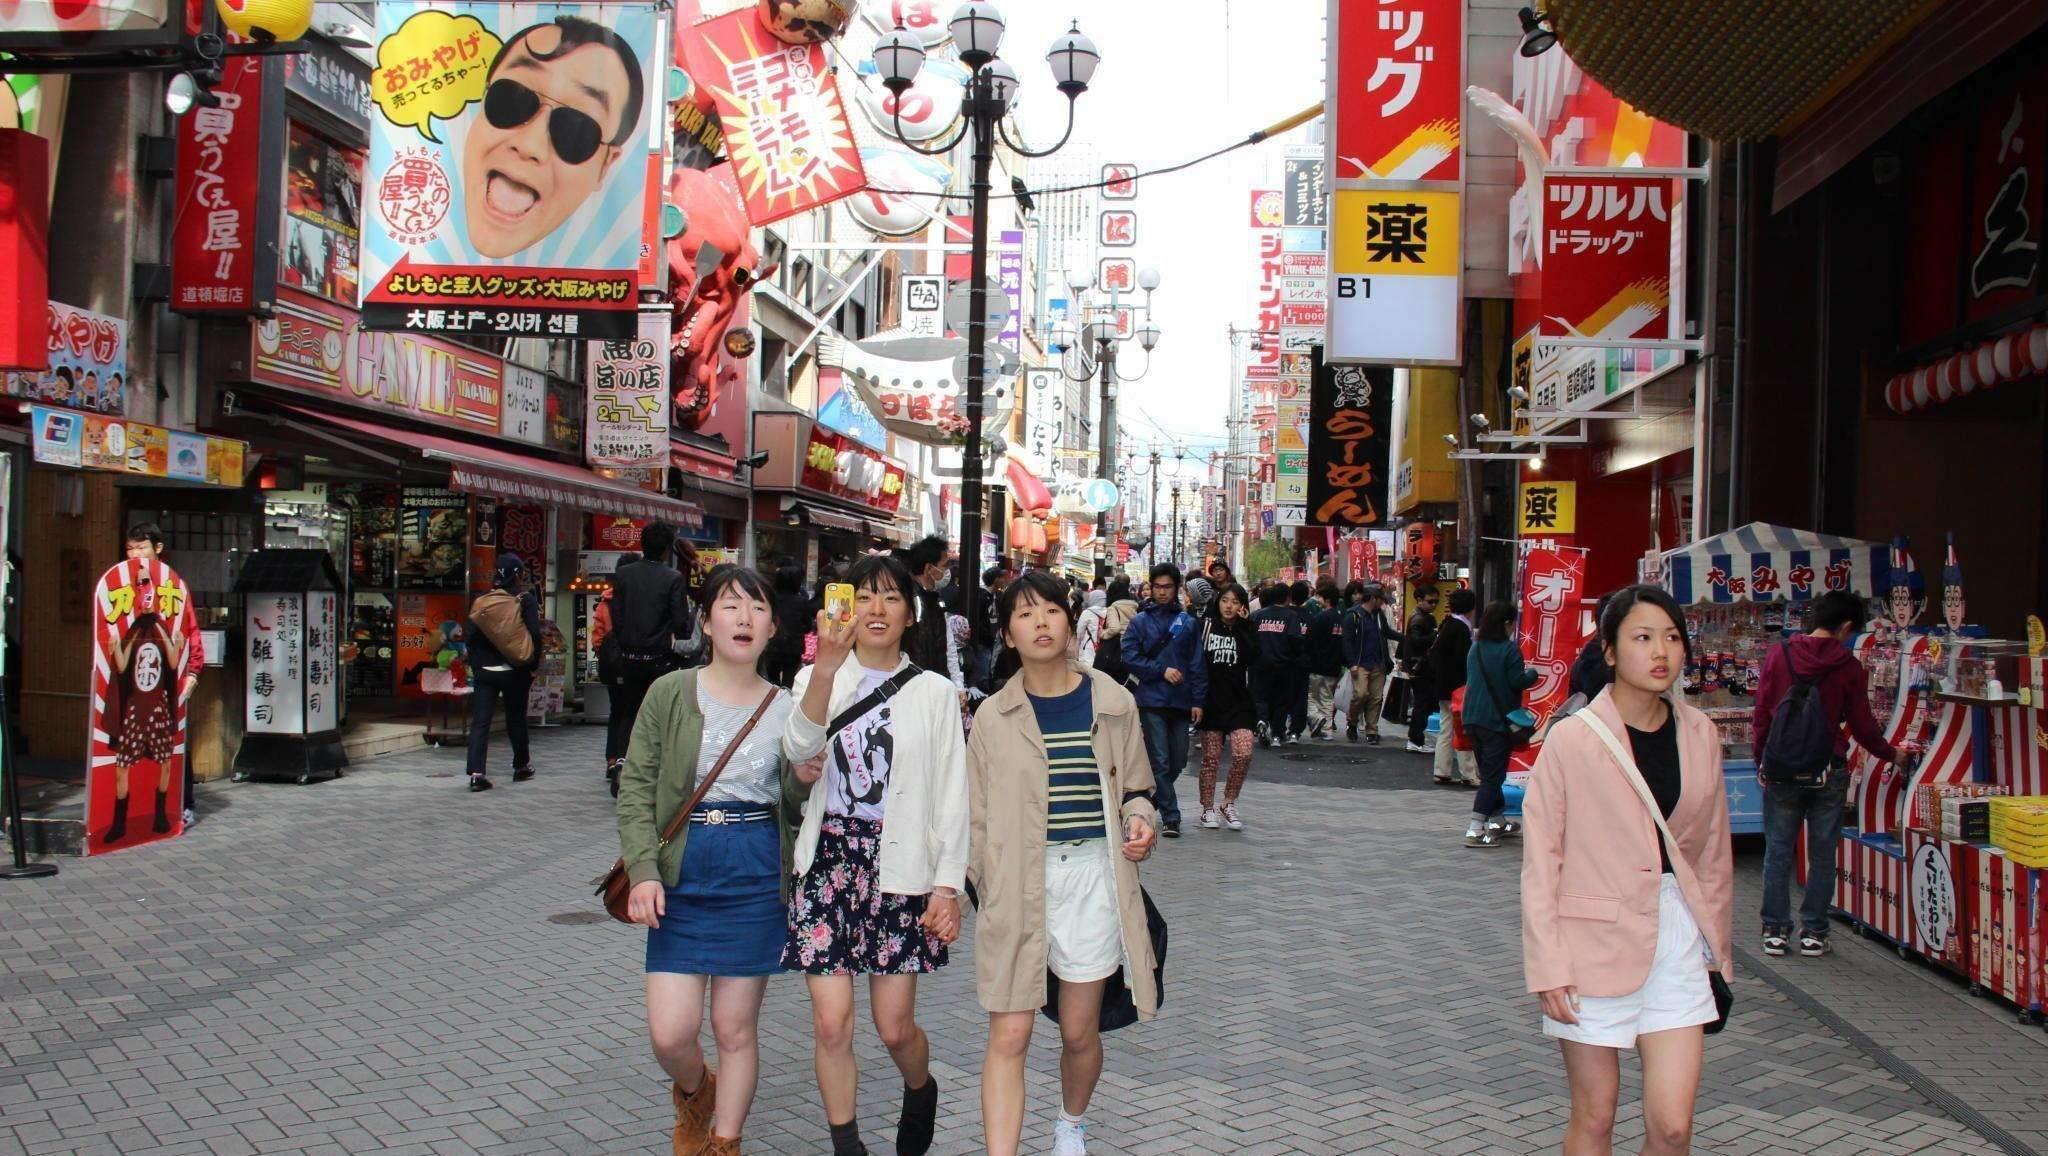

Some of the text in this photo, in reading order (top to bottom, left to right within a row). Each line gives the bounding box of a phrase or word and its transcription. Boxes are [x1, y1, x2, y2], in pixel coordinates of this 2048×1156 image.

[383, 31, 481, 93] おみやげ
[1367, 0, 1434, 118] ッグ
[1550, 185, 1667, 222] ツルハ
[1367, 203, 1427, 264] 薬
[1549, 229, 1644, 255] ドラッグ
[182, 287, 244, 303] 道頓堀店
[387, 274, 629, 300] よしもと芸人グッズ・大阪みやげ
[1337, 277, 1372, 299] B1
[346, 322, 456, 417] GAME
[596, 363, 662, 390] 旨い店
[1315, 408, 1377, 524] らーめん
[1525, 486, 1557, 528] 薬
[1706, 558, 1853, 595] 大阪みやげ
